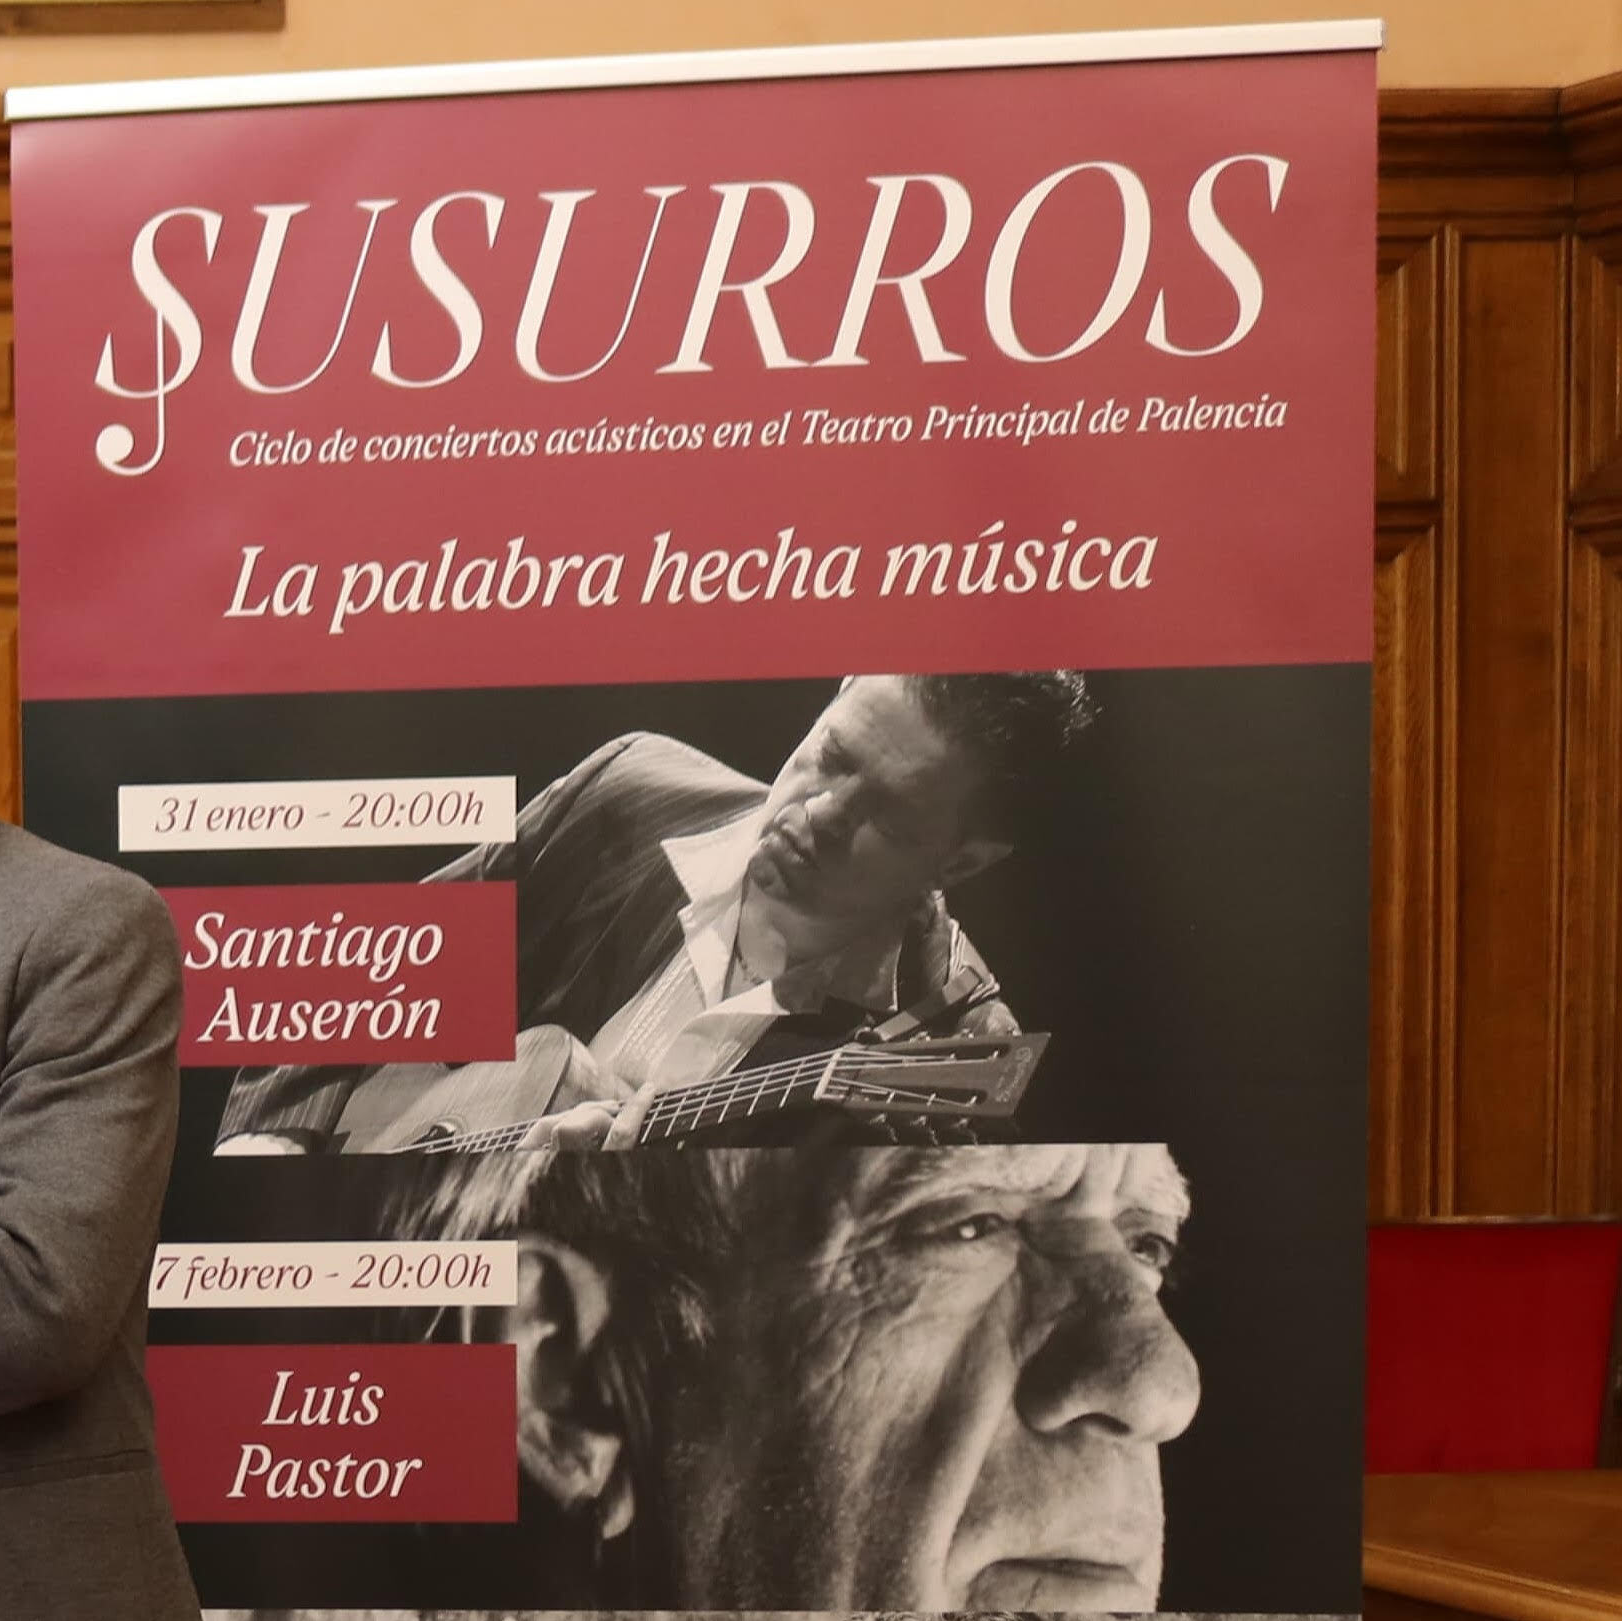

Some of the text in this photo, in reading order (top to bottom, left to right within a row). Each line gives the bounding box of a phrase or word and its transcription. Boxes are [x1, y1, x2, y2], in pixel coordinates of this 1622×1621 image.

[94, 153, 1290, 476] SUSURROS
[229, 393, 1288, 467] Ciclo de conciertos acústicos en el Teatro Principal de Palencia
[223, 519, 1159, 635] La palabra hecha música
[155, 799, 197, 832] 31
[207, 806, 304, 830] enero
[343, 791, 484, 828] 20:00h
[184, 911, 443, 983] Santiago
[196, 983, 441, 1043] Auserón
[184, 1256, 313, 1300] febrero
[350, 1254, 491, 1289] 20:00h
[261, 1370, 384, 1426] Luis
[226, 1444, 423, 1499] Pastor
